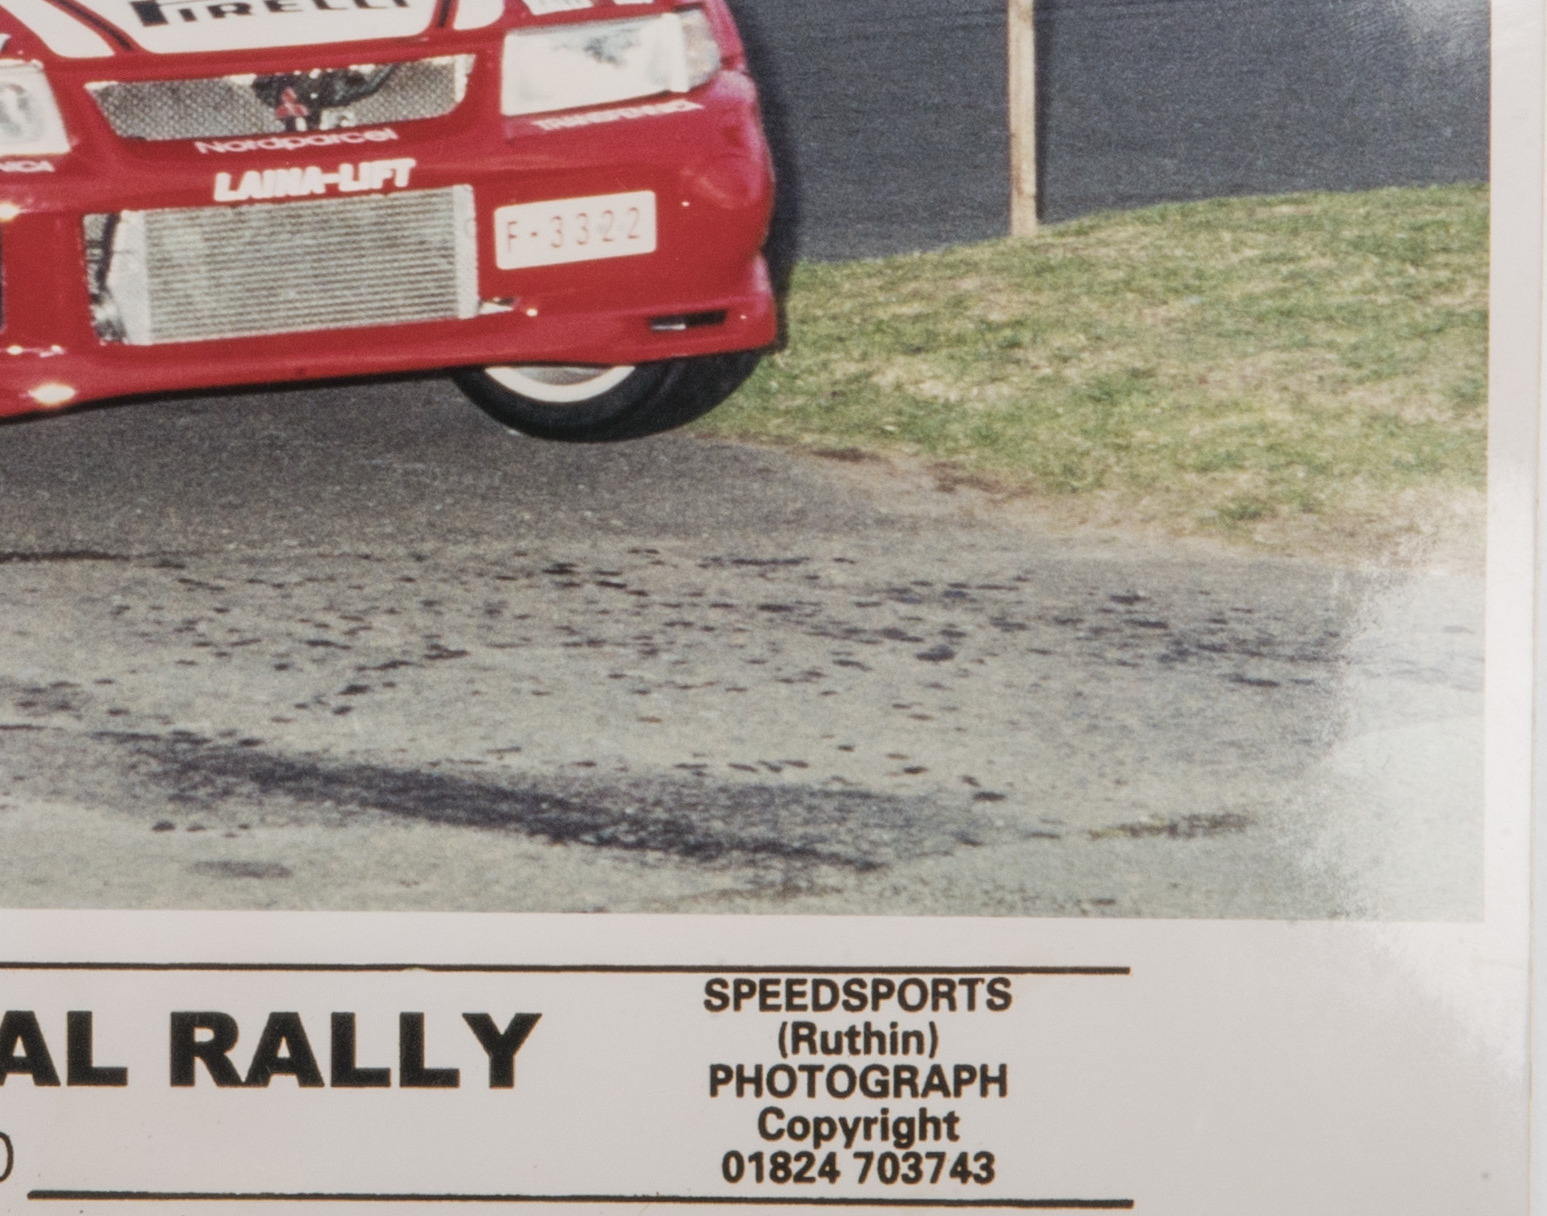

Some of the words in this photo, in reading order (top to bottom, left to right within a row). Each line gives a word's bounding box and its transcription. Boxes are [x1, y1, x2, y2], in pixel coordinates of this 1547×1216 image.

[194, 127, 400, 155] Nordparcel
[213, 157, 417, 202] LAINA-LIFT
[506, 206, 641, 255] F-3322
